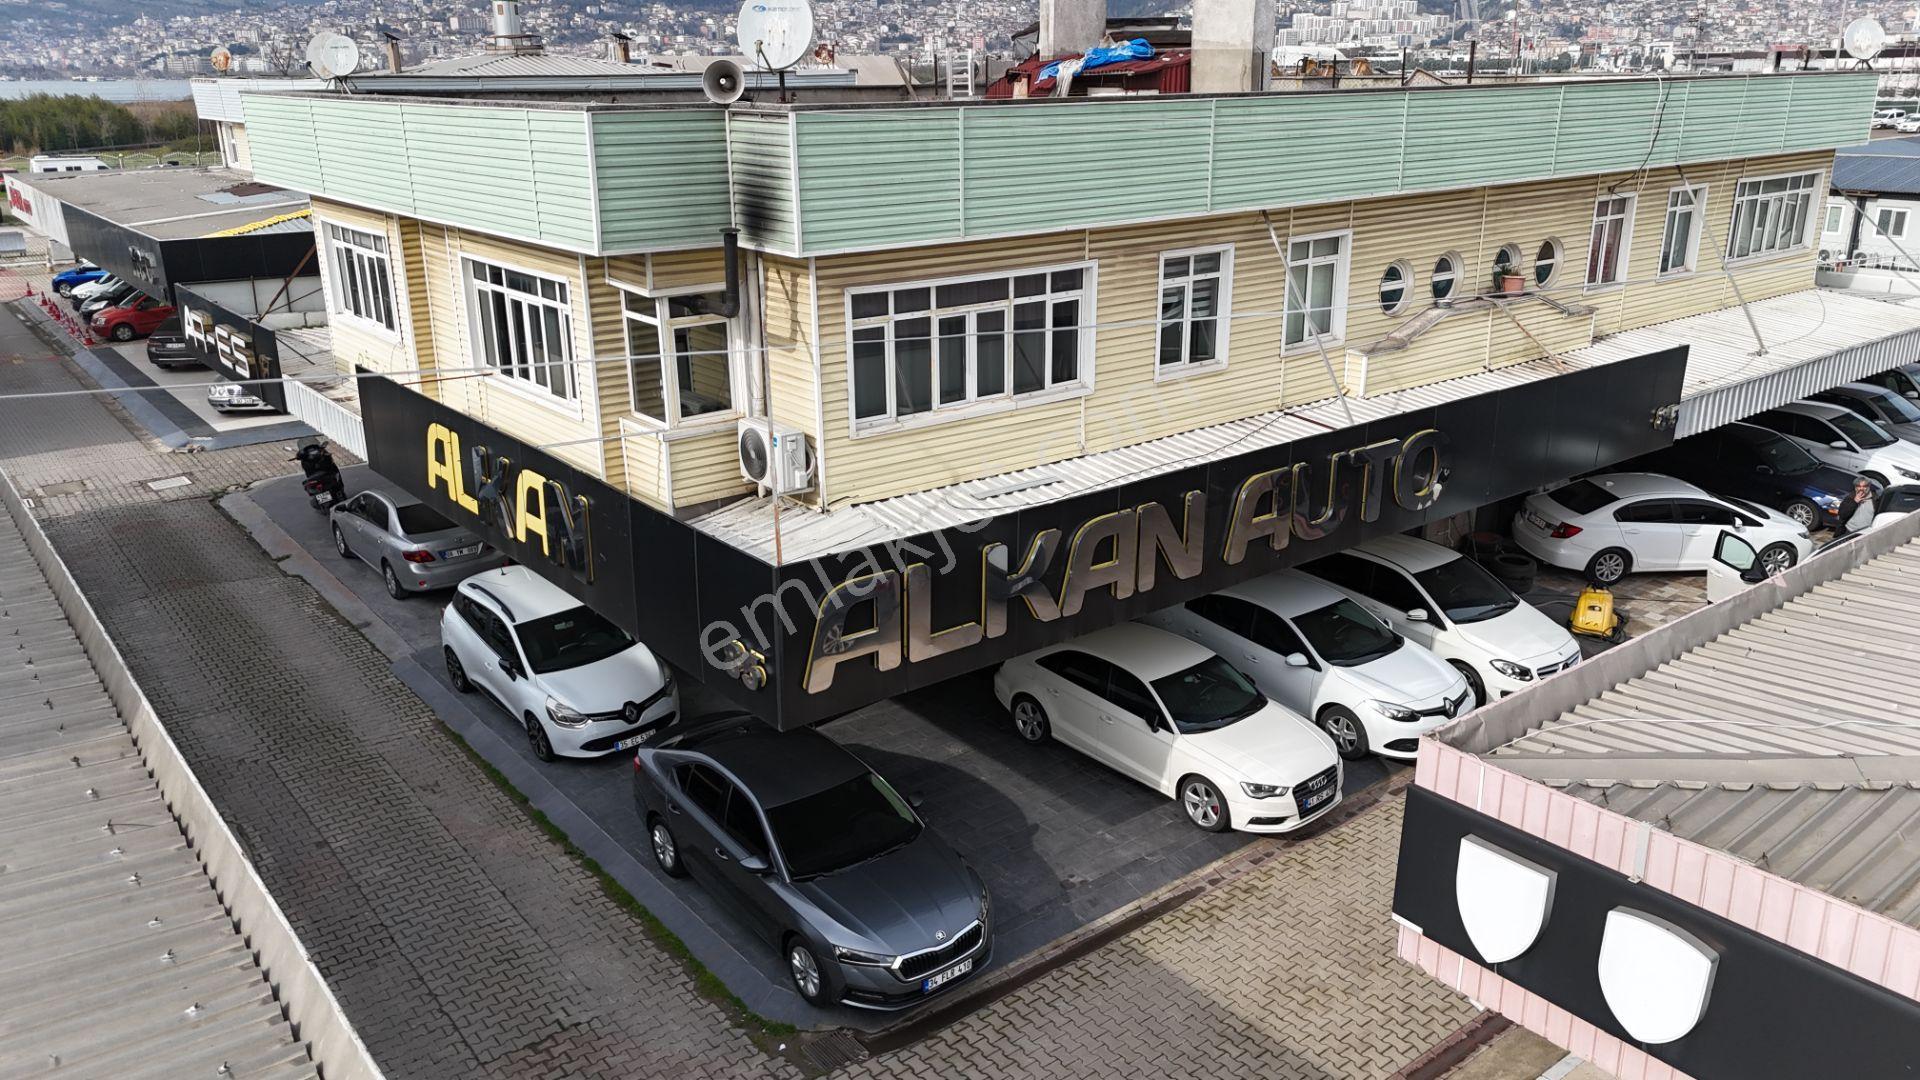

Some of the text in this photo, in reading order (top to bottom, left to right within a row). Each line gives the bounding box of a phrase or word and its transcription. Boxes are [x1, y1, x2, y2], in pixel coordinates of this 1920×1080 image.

[427, 422, 597, 584] ALKAN
[803, 428, 1450, 694] ALKAN AUTO
